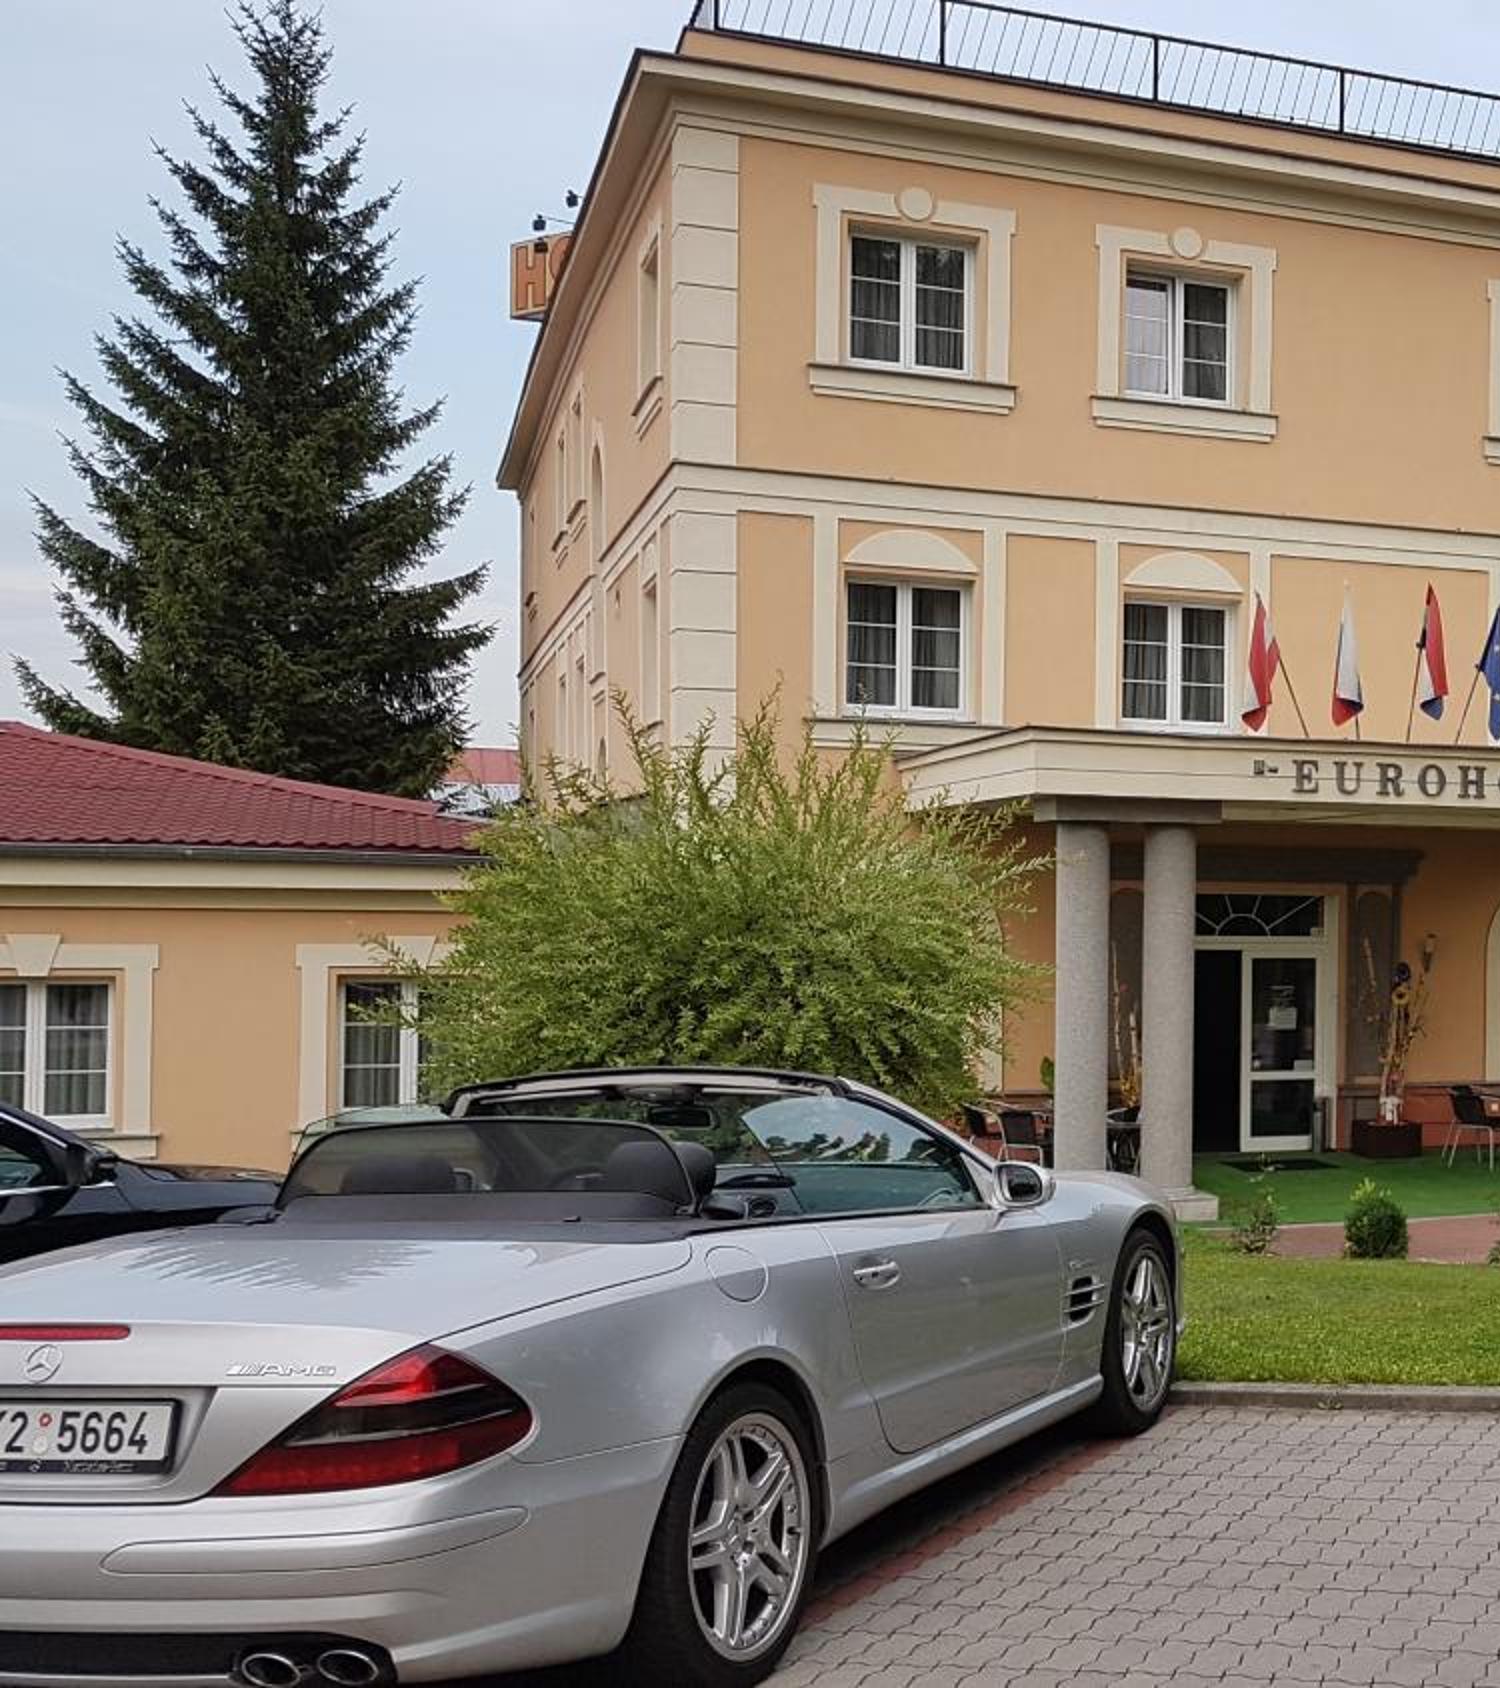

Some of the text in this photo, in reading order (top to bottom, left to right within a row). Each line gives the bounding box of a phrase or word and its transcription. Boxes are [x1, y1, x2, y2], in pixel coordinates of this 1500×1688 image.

[259, 1364, 337, 1377] AMG
[0, 1410, 148, 1454] 2 5664
